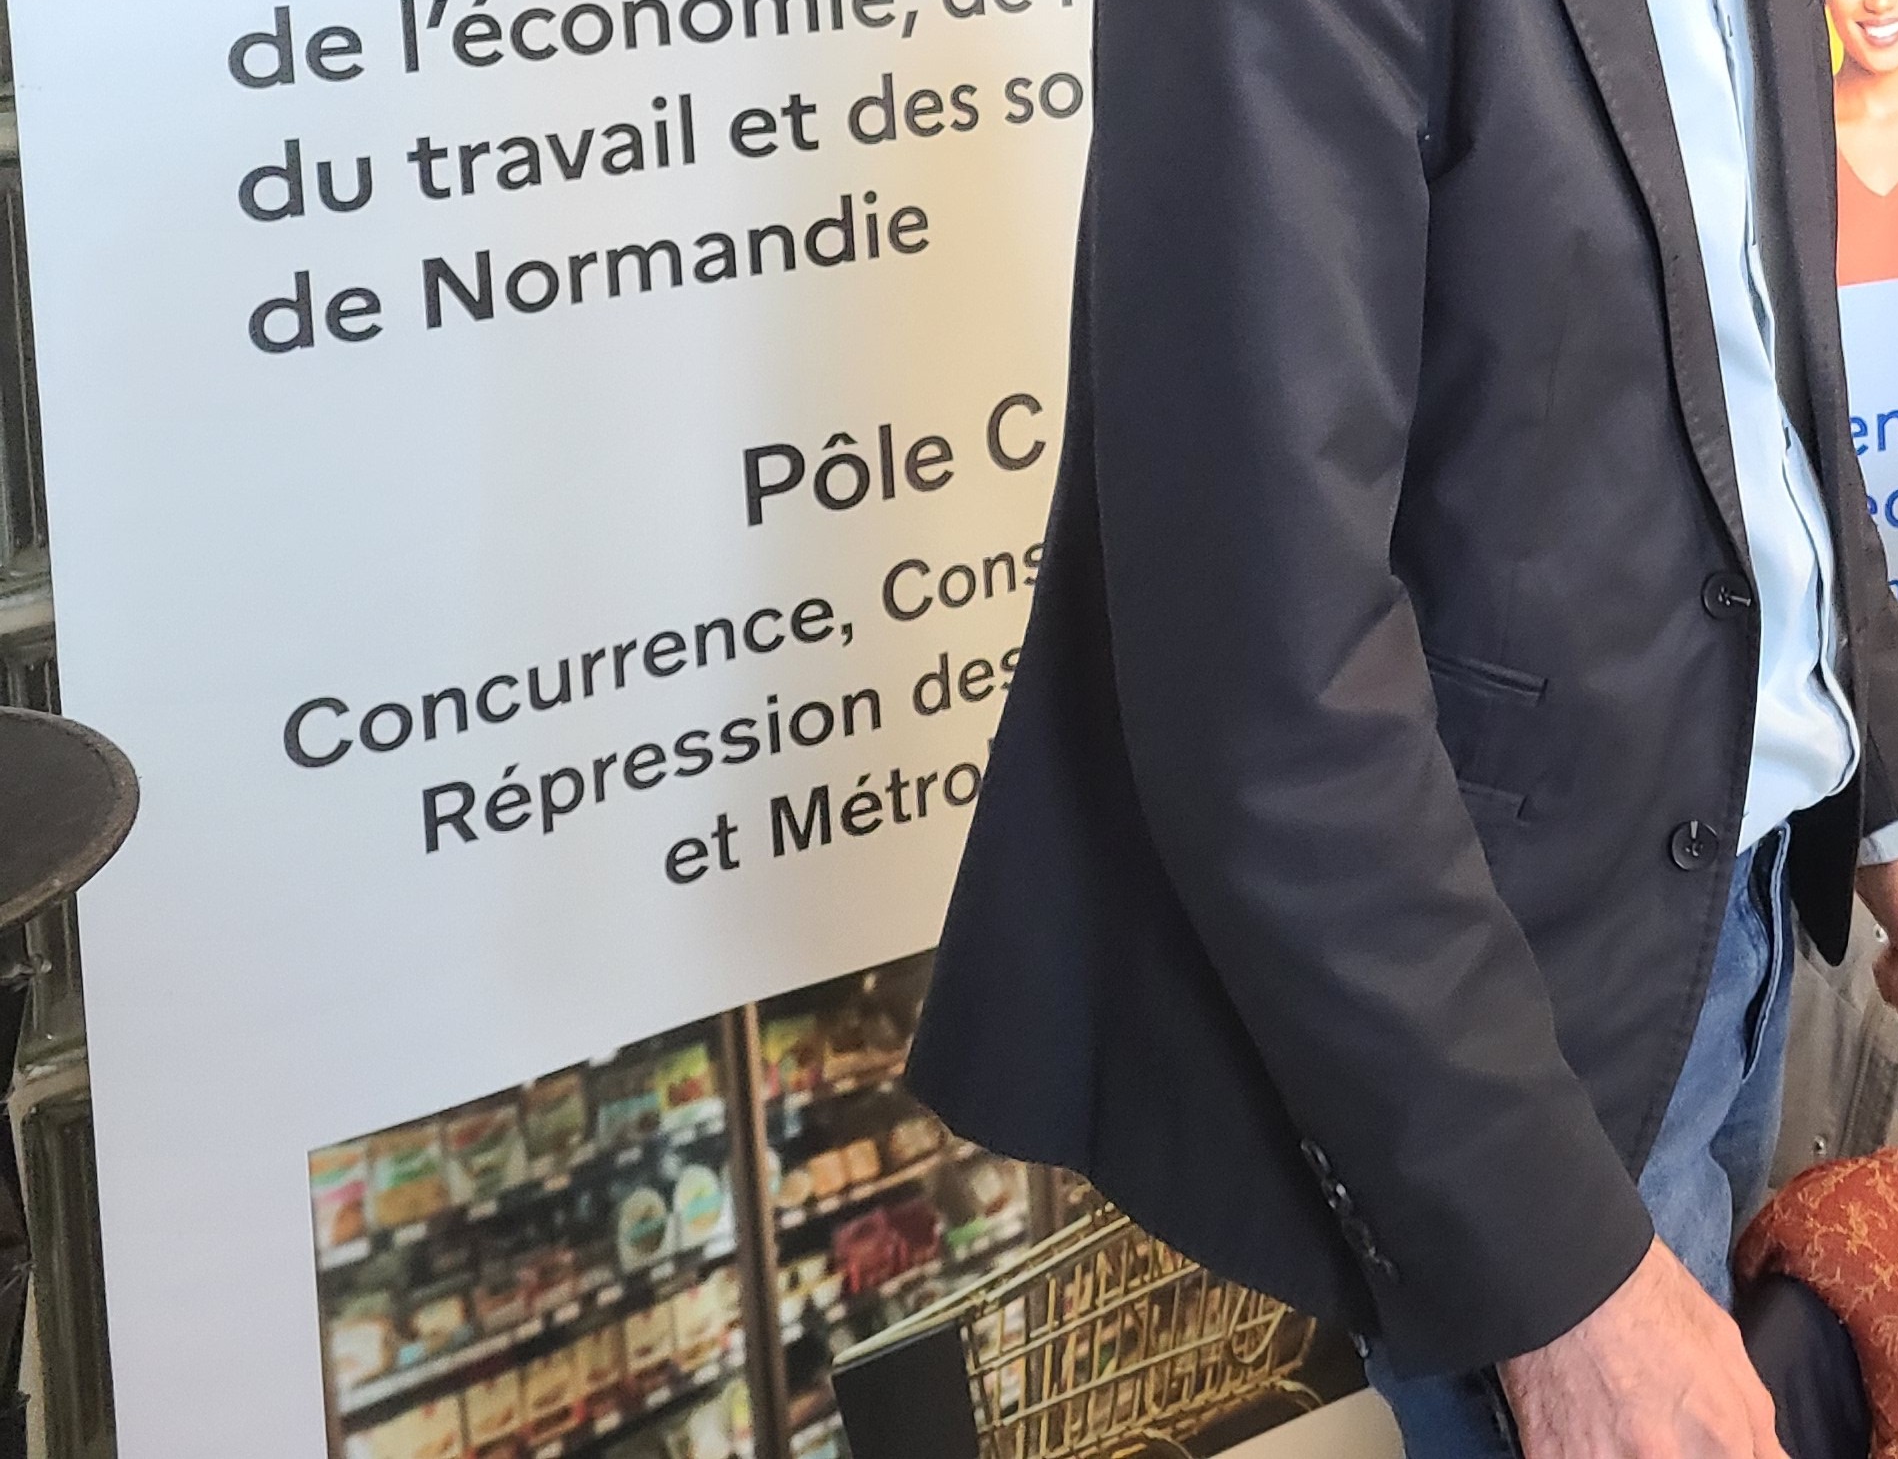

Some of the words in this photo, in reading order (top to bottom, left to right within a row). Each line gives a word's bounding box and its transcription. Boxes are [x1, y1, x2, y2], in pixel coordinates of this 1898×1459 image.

[227, 5, 366, 91] de
[237, 138, 374, 224] du
[407, 92, 697, 203] travail
[729, 91, 819, 159] et
[847, 72, 980, 147] des
[247, 269, 383, 356] de
[424, 189, 931, 329] Normandie
[743, 423, 956, 527] Pôle
[282, 596, 854, 770] Concurrence,
[422, 687, 883, 854] Répression
[664, 812, 741, 886] et
[769, 749, 986, 860] Métro
